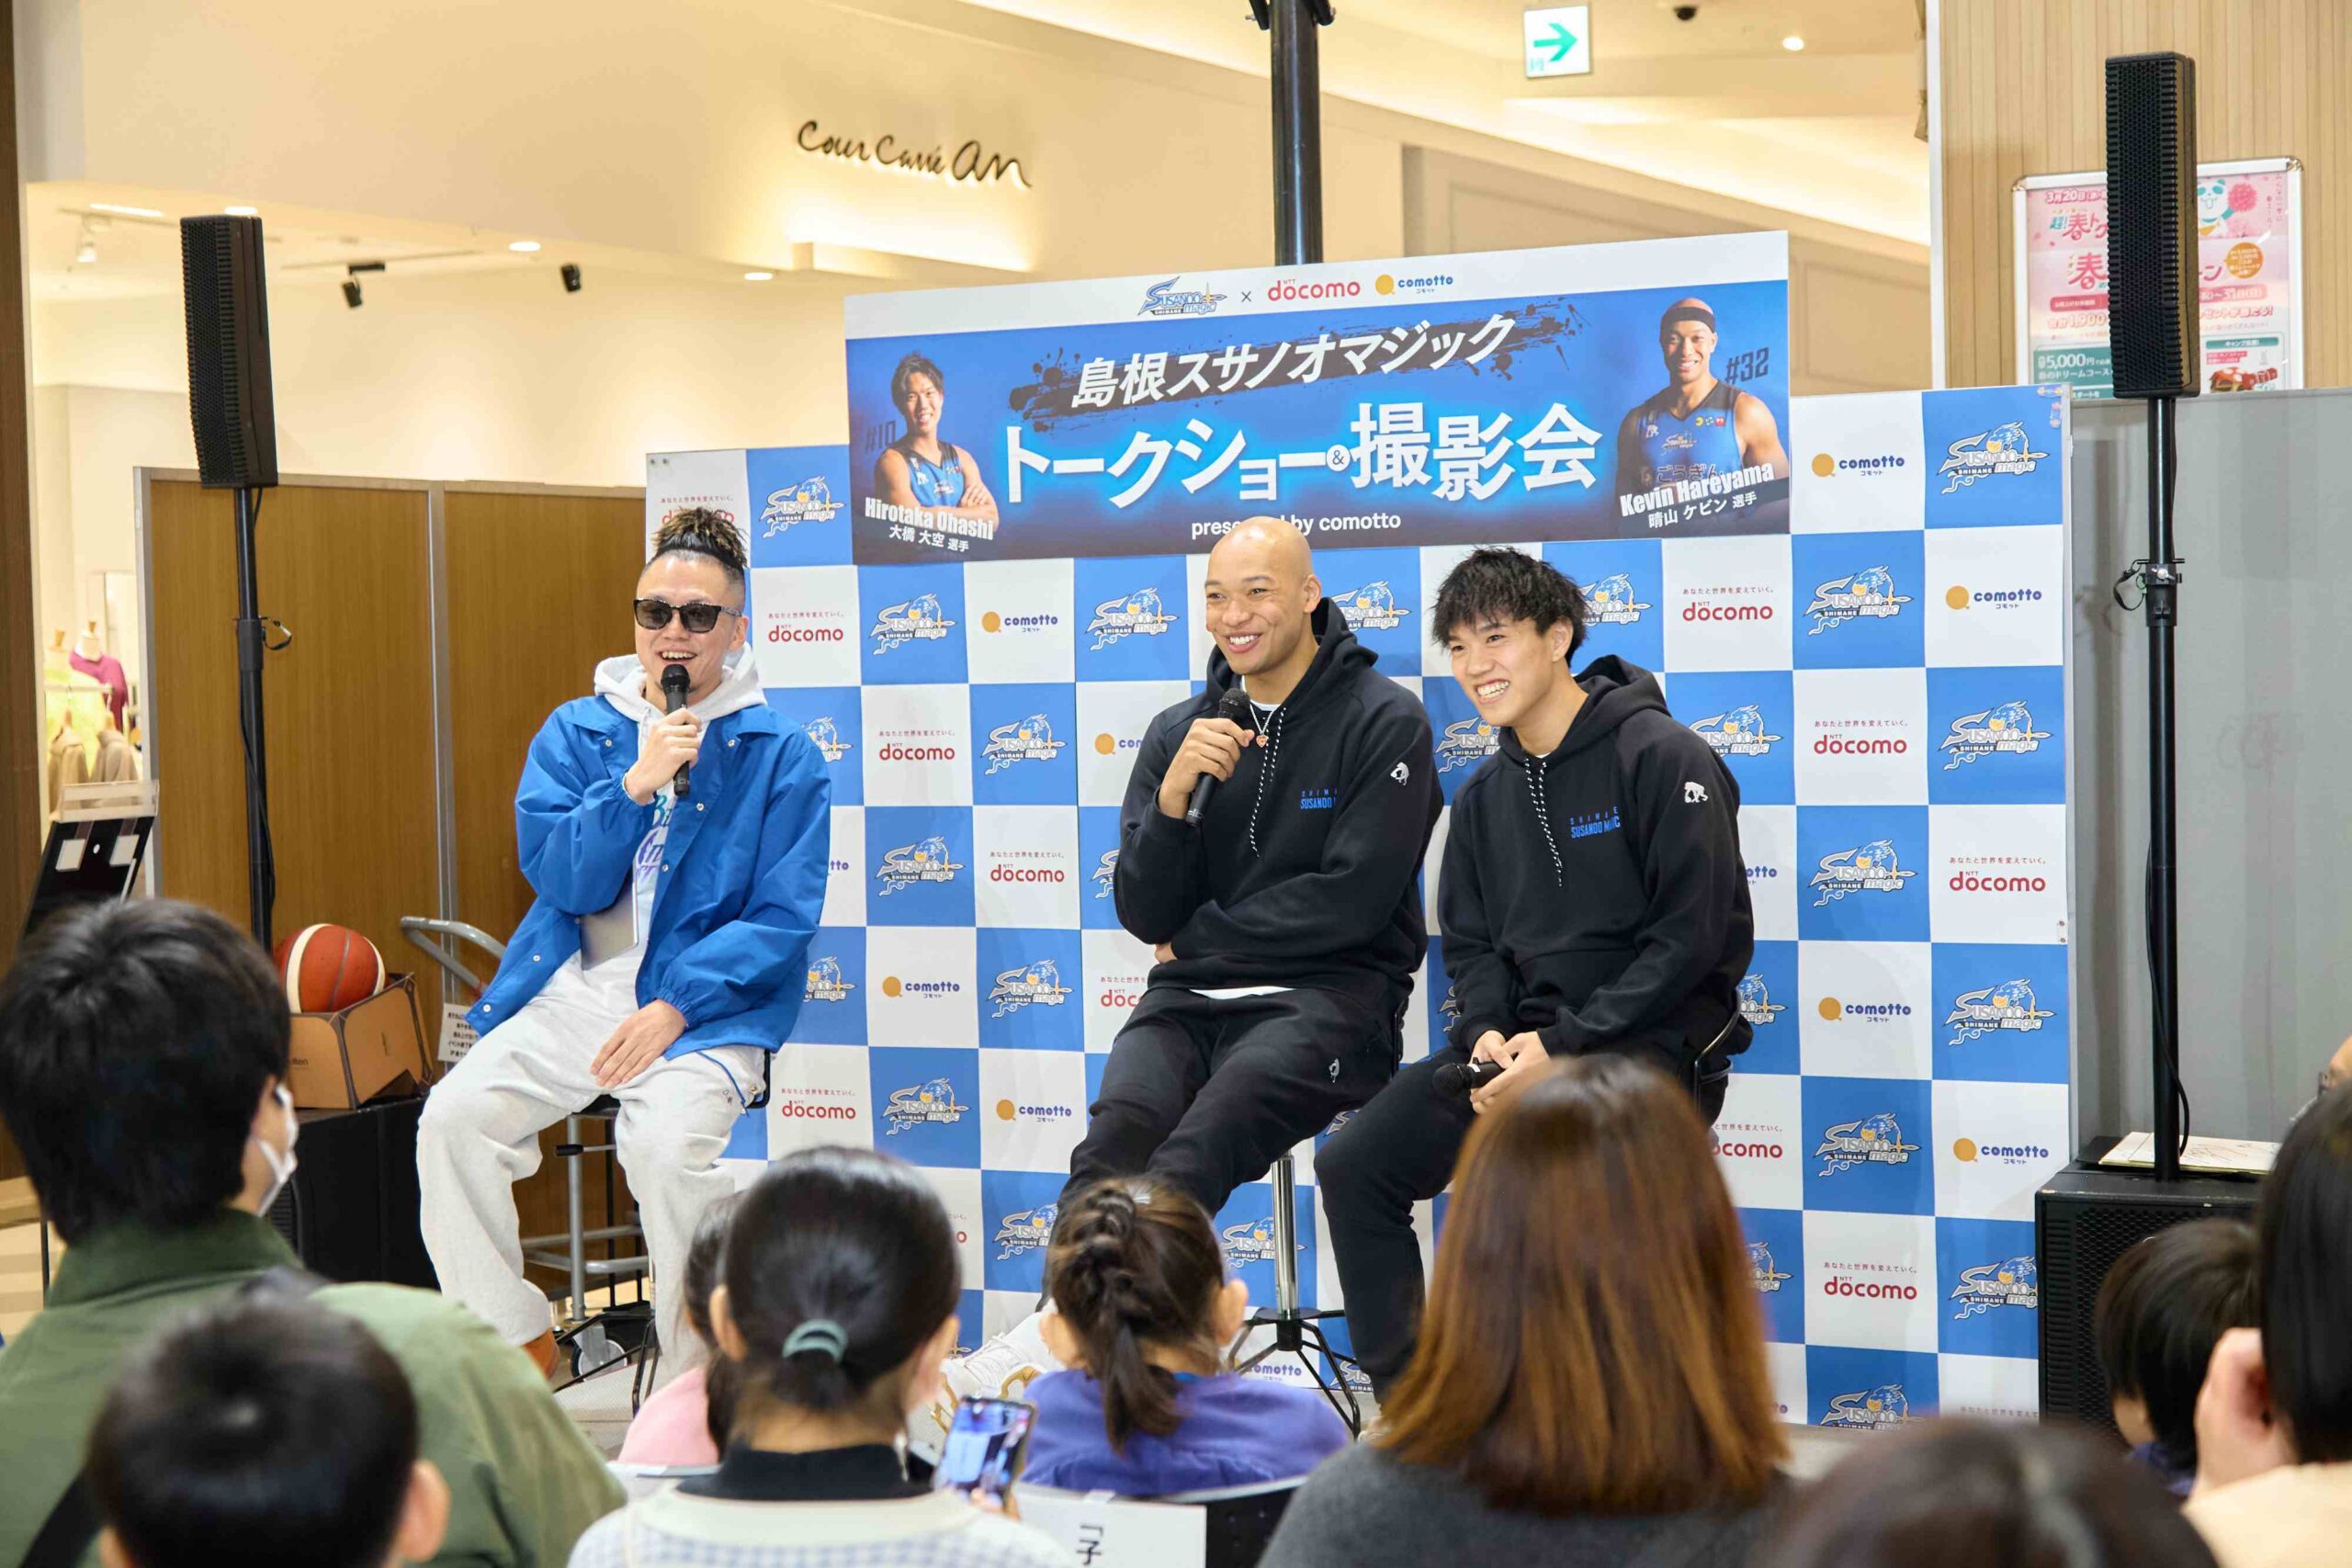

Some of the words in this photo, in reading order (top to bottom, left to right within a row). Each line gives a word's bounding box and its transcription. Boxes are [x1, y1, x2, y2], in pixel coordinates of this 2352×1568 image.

[797, 119, 871, 161] Cour
[1267, 280, 1362, 302] docomo
[1397, 275, 1454, 288] comotto
[1070, 313, 1517, 410] 島根スサノオマジック
[1724, 346, 1770, 385] #32
[1838, 455, 1905, 469] comotto
[1939, 432, 2018, 475] SUSANOO
[1994, 461, 2036, 475] magic
[1619, 484, 1674, 517] Kevin
[1675, 462, 1775, 505] Hareyama
[1682, 499, 1728, 522] ケビン
[1732, 491, 1758, 510] 選手
[865, 497, 933, 530] Hirotaka
[936, 510, 994, 541] Ohashi
[1318, 512, 1402, 532] comotto
[888, 525, 916, 544] 大橋
[918, 531, 944, 548] 大空
[947, 539, 970, 554] 選手
[1682, 587, 1773, 595] あなたと世界を変えていく。
[1804, 574, 1883, 616] SUSANOO
[1973, 588, 2042, 603] comotto
[1682, 603, 1773, 622] docomo
[1859, 603, 1901, 617] magic
[1003, 614, 1058, 626] comotto
[768, 626, 843, 642] docomo
[1940, 708, 2021, 750] SUSANOO
[878, 744, 956, 761] docomo
[1814, 735, 1907, 754] docomo
[1996, 739, 2039, 753] magic
[1810, 848, 1886, 886] SUSANOO
[1949, 857, 2047, 865] あなたと世界を変えていく。
[989, 864, 1066, 883] docomo
[1949, 872, 2047, 892] docomo
[1862, 877, 1905, 891] magic
[904, 980, 961, 993] comotto
[1845, 1003, 1912, 1016] comotto
[1945, 987, 2024, 1026] SUSANOO
[1999, 1017, 2043, 1032] magic
[782, 1100, 856, 1120] docomo
[1018, 1104, 1072, 1118] comotto
[1714, 1123, 1783, 1133] と世界を変えていく。
[1815, 1120, 1891, 1157] SUSANOO
[1867, 1149, 1909, 1164] magic
[1981, 1145, 2050, 1159] comotto
[1824, 1261, 1918, 1274] あなたと世界を変えていく。
[1824, 1276, 1918, 1301] docomo
[1951, 1262, 2030, 1299] SUSANOO
[2006, 1293, 2038, 1309] mag
